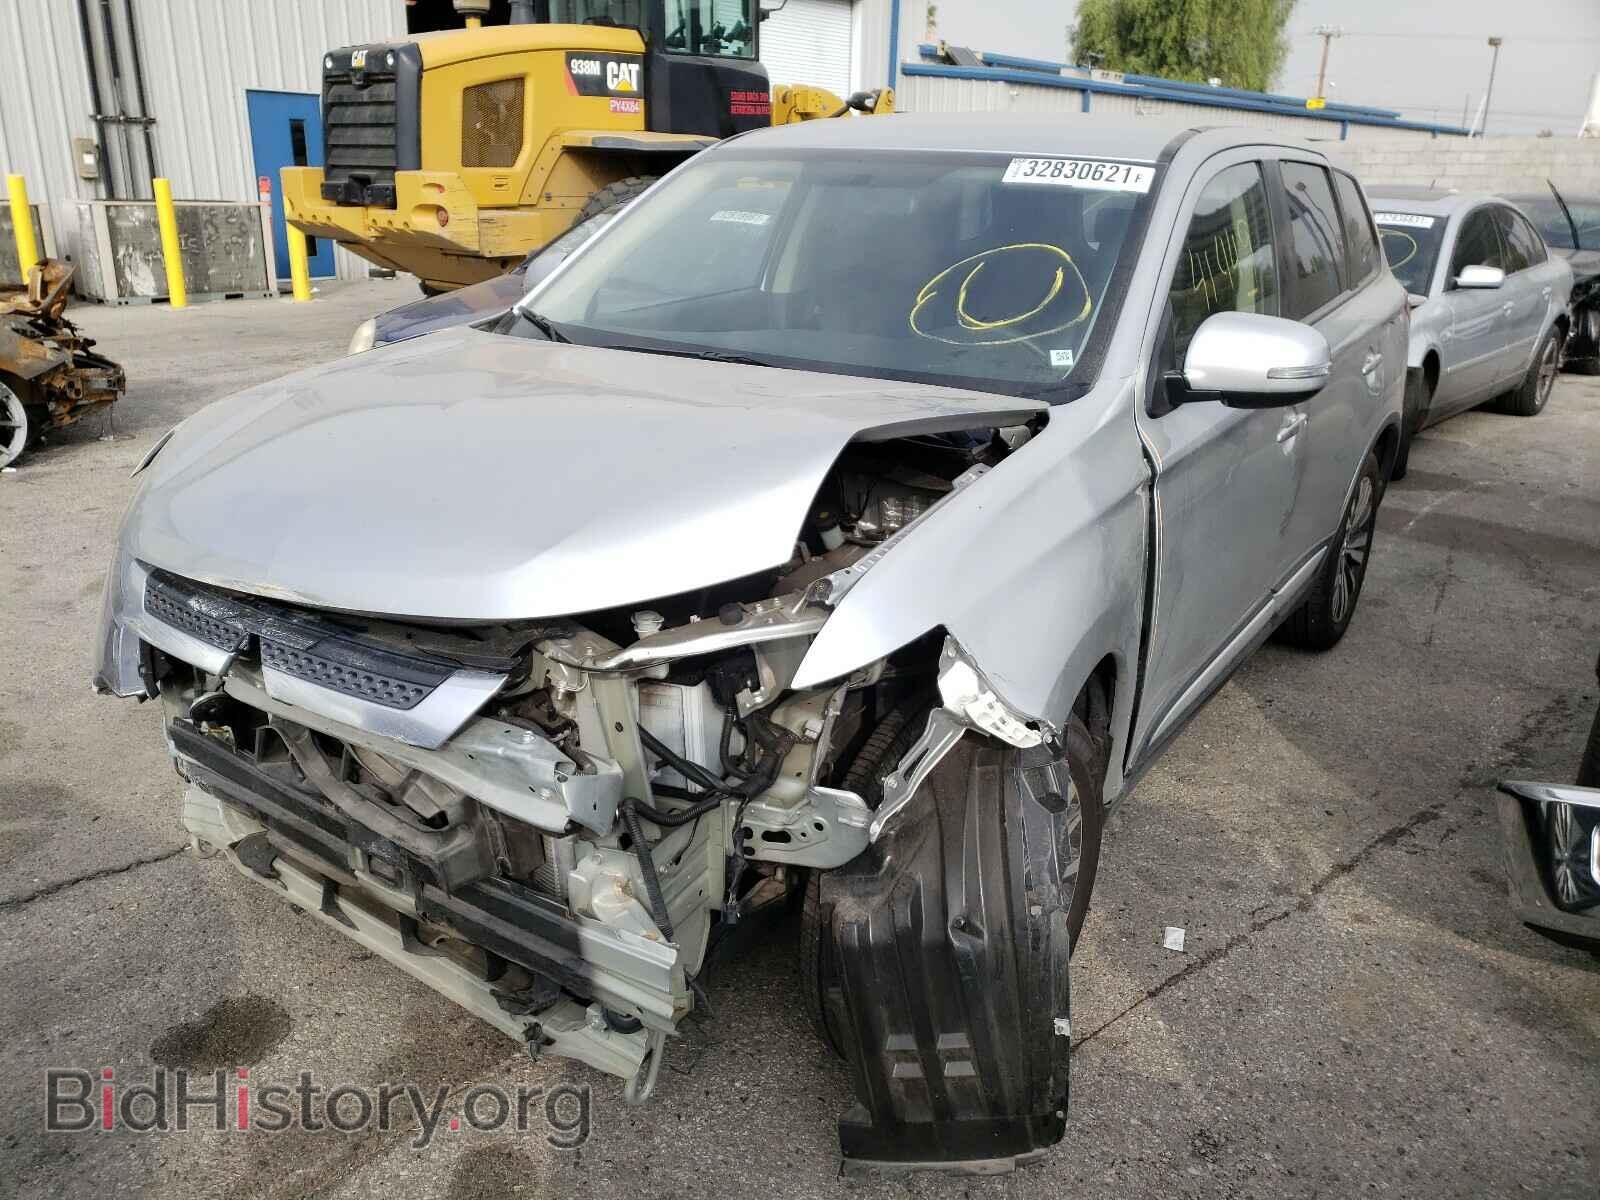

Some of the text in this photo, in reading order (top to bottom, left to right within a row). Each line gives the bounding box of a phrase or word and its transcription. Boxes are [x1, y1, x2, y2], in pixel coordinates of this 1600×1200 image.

[352, 50, 369, 66] CAT
[570, 58, 600, 75] 938M
[606, 61, 640, 91] CAT
[1023, 160, 1132, 184] 32830621
